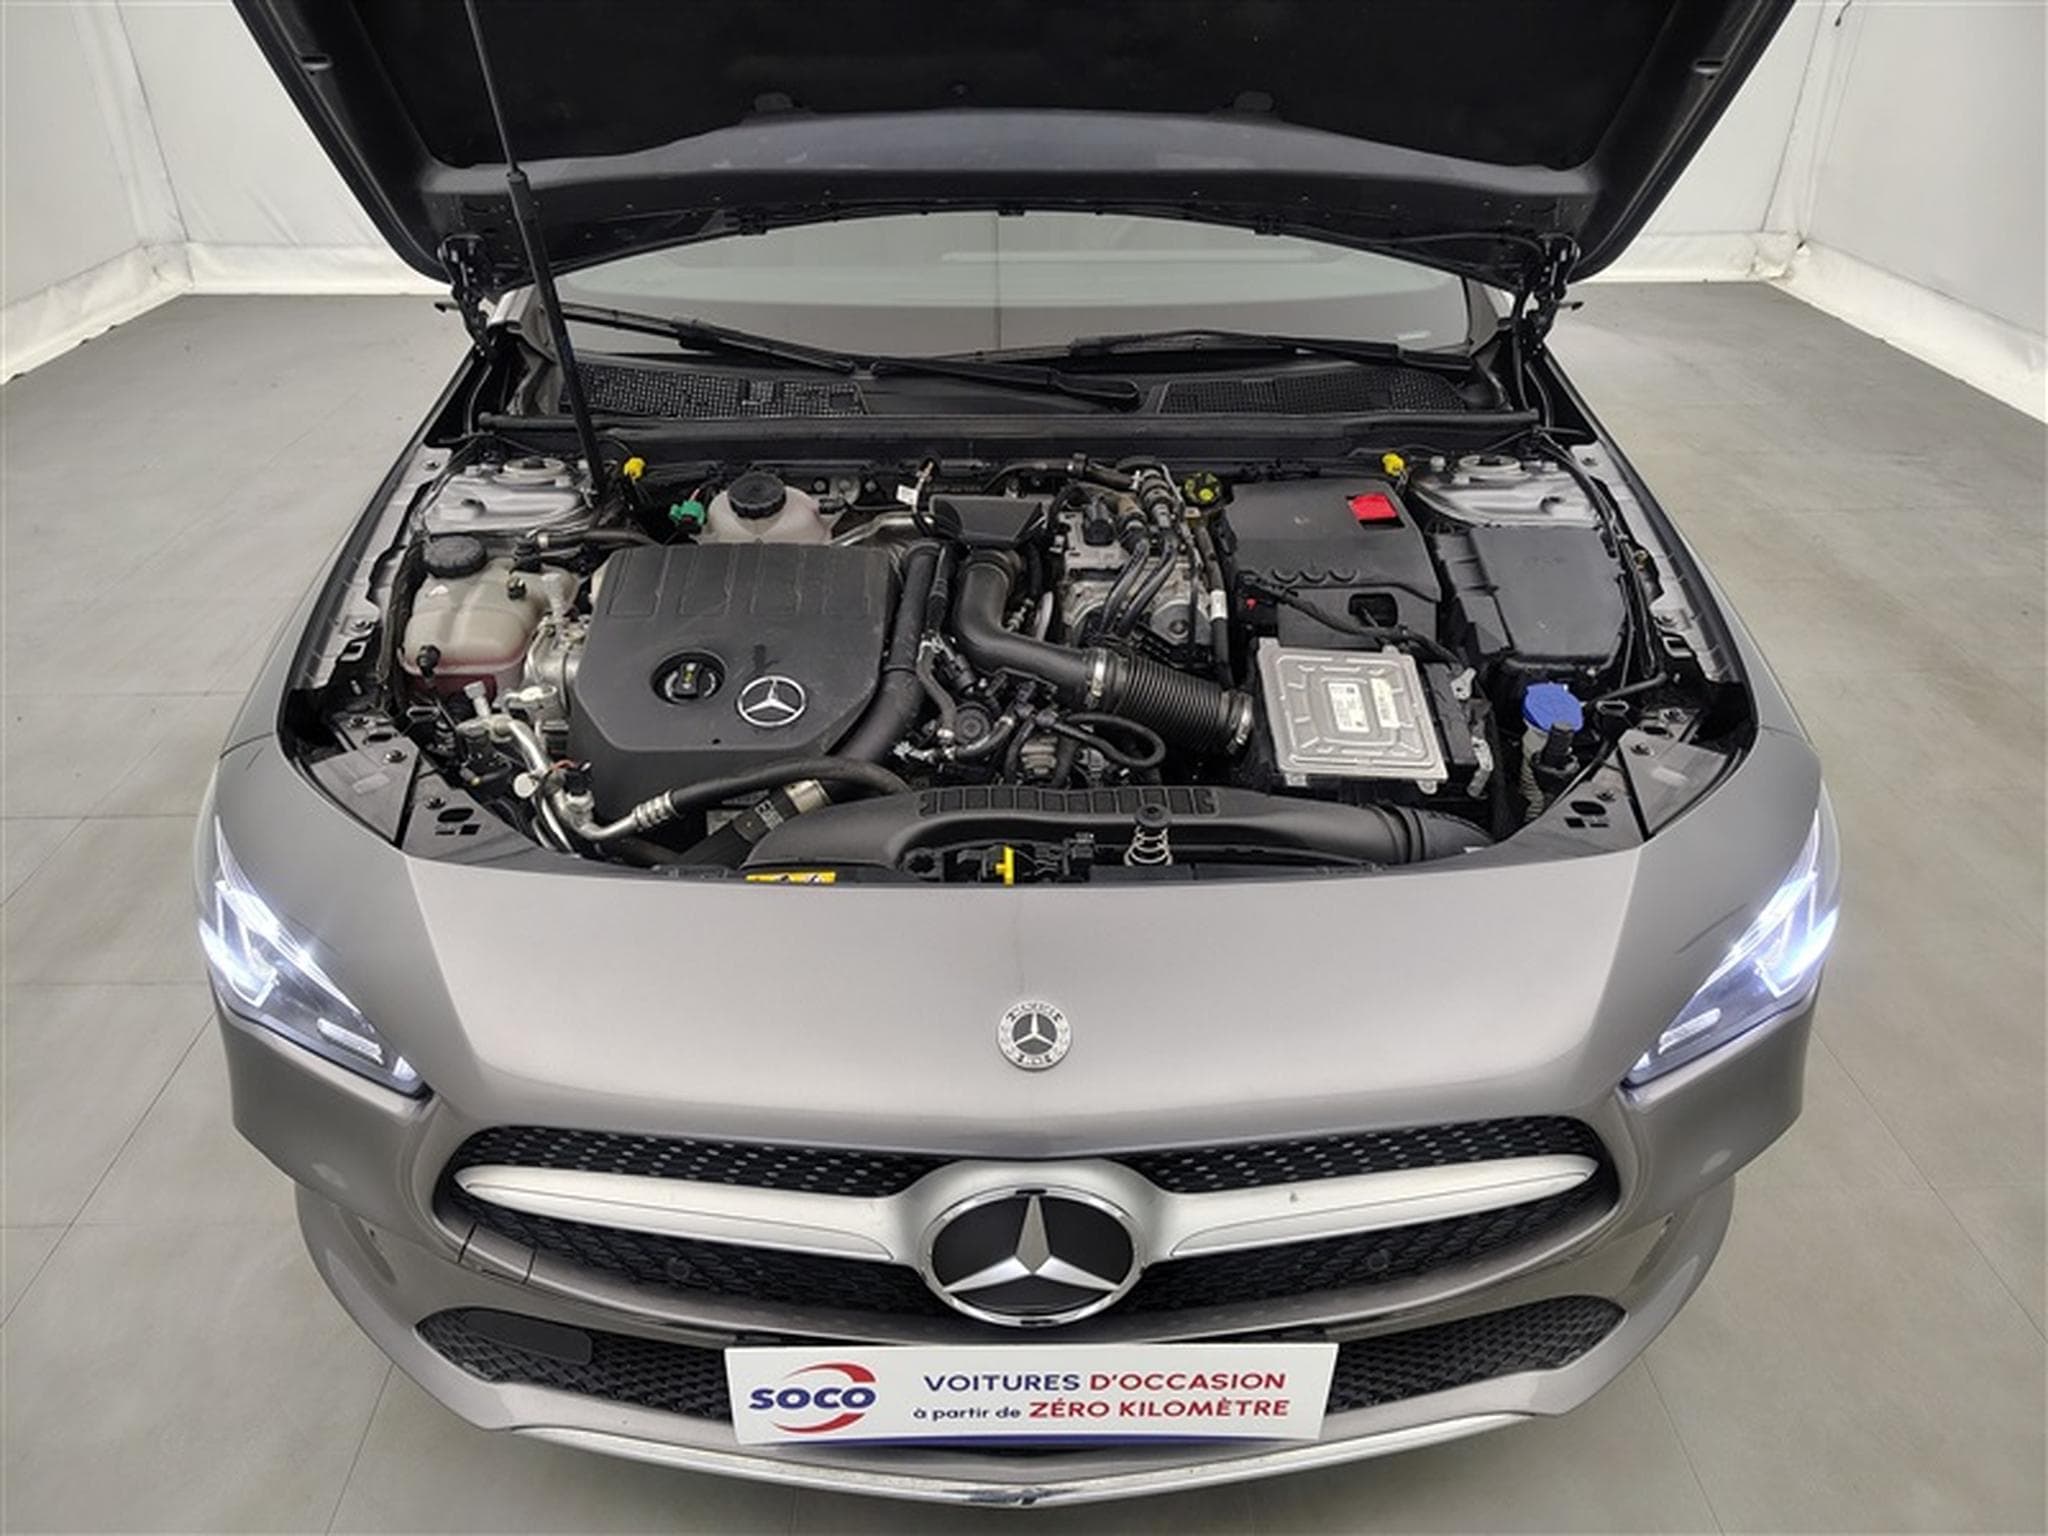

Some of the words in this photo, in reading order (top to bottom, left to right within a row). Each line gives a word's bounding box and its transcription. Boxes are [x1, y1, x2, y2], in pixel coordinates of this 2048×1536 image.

[923, 1374, 1081, 1392] VOITURES
[1089, 1373, 1286, 1391] D'OCCASION
[749, 1387, 877, 1410] SOCO
[913, 1408, 927, 1420] à
[932, 1407, 990, 1422] partir
[995, 1407, 1021, 1420] de
[1029, 1397, 1110, 1419] ZÉRO
[1119, 1397, 1291, 1418] KILOMÈTRE
